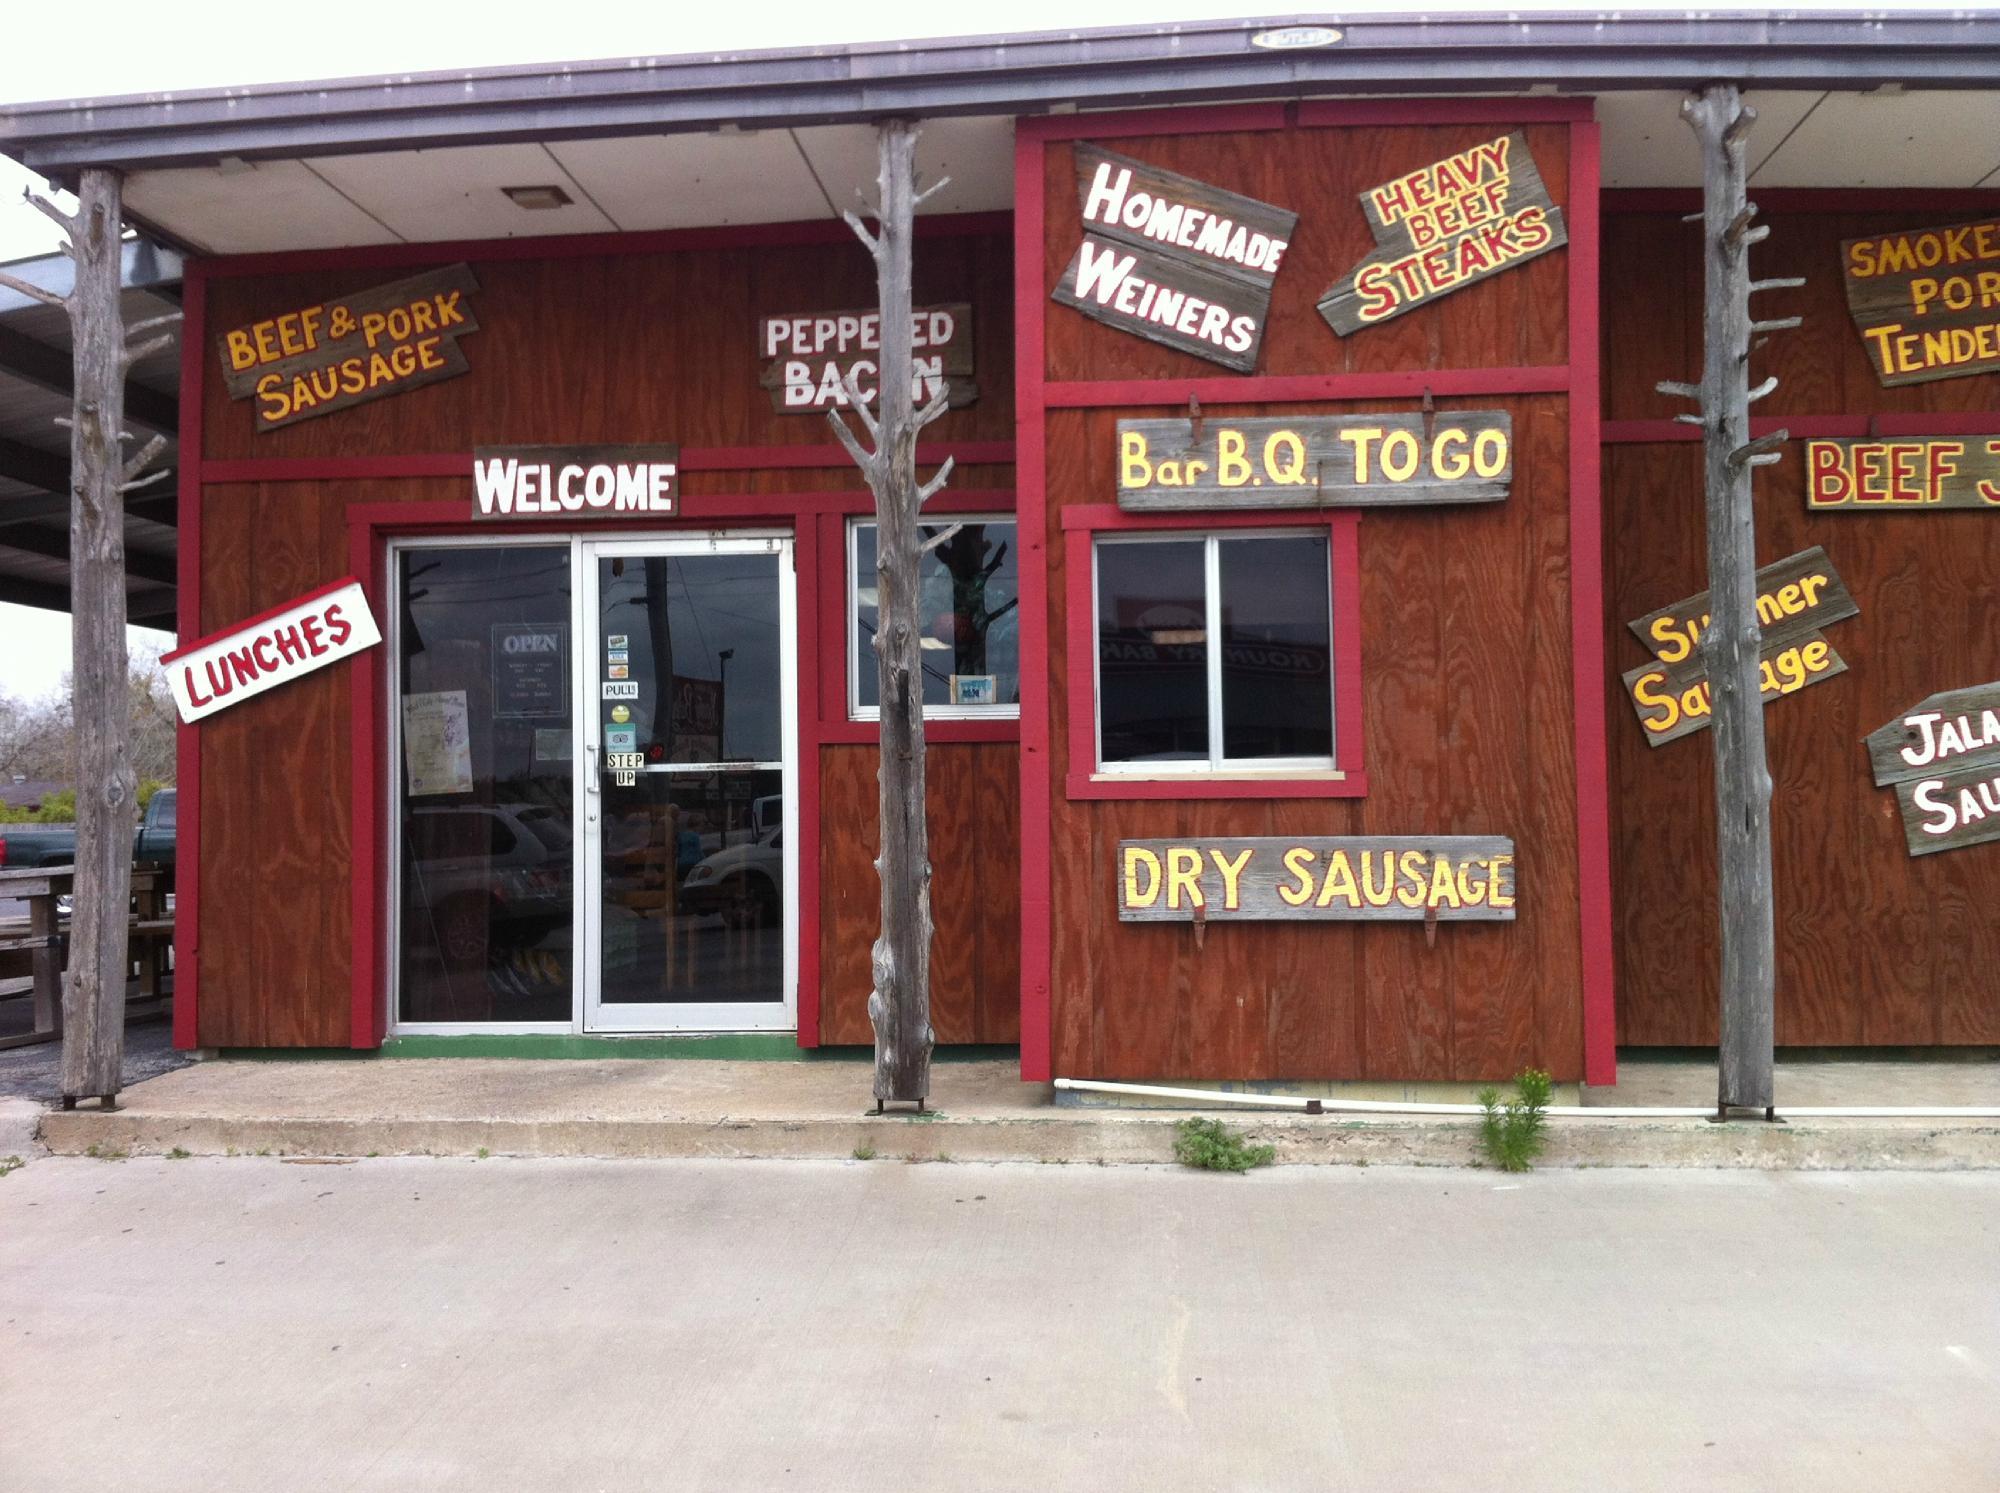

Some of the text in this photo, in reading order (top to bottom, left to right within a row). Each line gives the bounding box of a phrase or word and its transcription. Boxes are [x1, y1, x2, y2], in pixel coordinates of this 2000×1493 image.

[1371, 136, 1510, 227] HEAVY
[1405, 176, 1510, 250] BEEF
[1083, 162, 1288, 273] HOMEMADE
[1354, 206, 1552, 321] STEAKS
[1850, 224, 2000, 278] SMOKE
[1075, 242, 1256, 352] WEINERS
[226, 290, 464, 371] BEEF & PORK
[767, 311, 954, 357] PEPPEED
[1864, 323, 2000, 375] TENDE
[256, 335, 445, 422] SAUSAGE
[785, 356, 943, 406] BACN
[474, 458, 676, 515] WELCOME
[1121, 431, 1208, 488] Bar
[1340, 428, 1419, 484] TO
[1430, 428, 1508, 481] GO
[1809, 441, 1964, 506] BEEF
[185, 603, 352, 709] LUNCHES
[503, 634, 559, 654] OPEN
[1634, 641, 1829, 732] Saage
[608, 754, 643, 768] STEP
[617, 771, 634, 785] UP
[1914, 777, 2000, 834] SAU
[1123, 847, 1516, 910] DRY SAUSAGE
